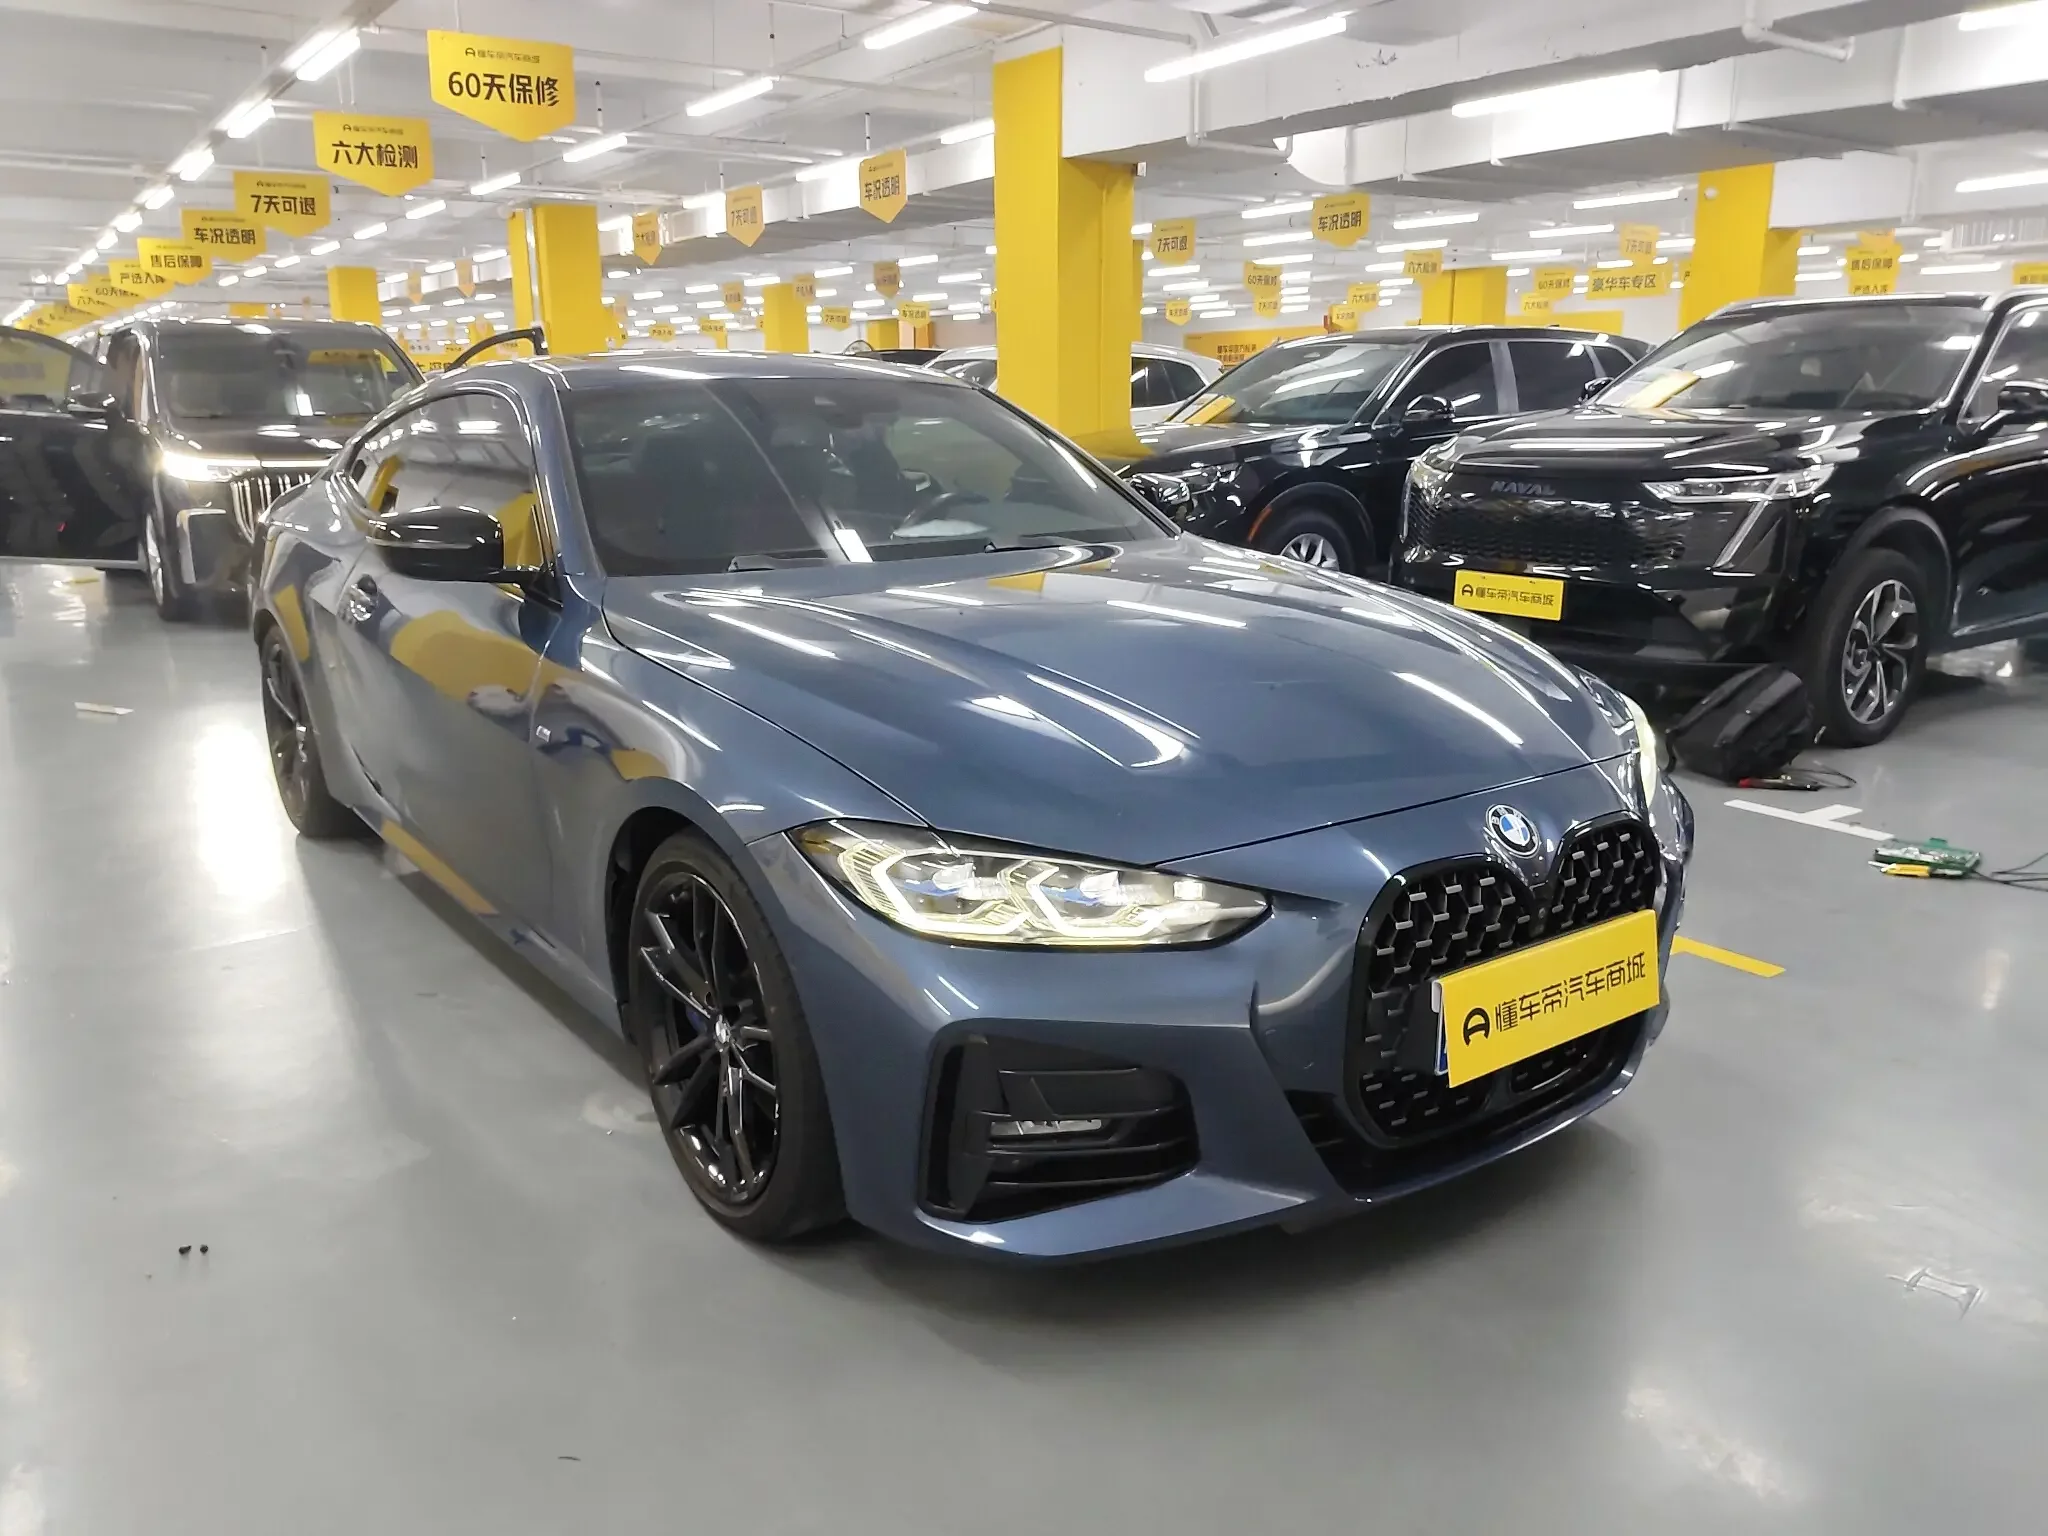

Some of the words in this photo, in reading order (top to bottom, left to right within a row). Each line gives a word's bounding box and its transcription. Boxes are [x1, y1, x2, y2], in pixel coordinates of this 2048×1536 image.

[448, 71, 560, 107] 60天保修
[331, 140, 418, 169] 六大检测
[864, 175, 900, 202] 车况透明
[250, 194, 316, 216] 7天可退
[1317, 210, 1362, 232] 车况透明
[194, 227, 256, 245] 车况透明
[1157, 236, 1188, 252] 7天可退
[150, 255, 203, 268] 售后保障
[1406, 260, 1438, 274] 六大检测
[1851, 257, 1893, 271] 售后保障
[1592, 273, 1657, 292] 豪华车专区
[1491, 480, 1556, 496] HAVAL
[1475, 586, 1555, 607] 懂车帝汽车商城
[1495, 951, 1647, 1032] 懂车帝汽车商城
